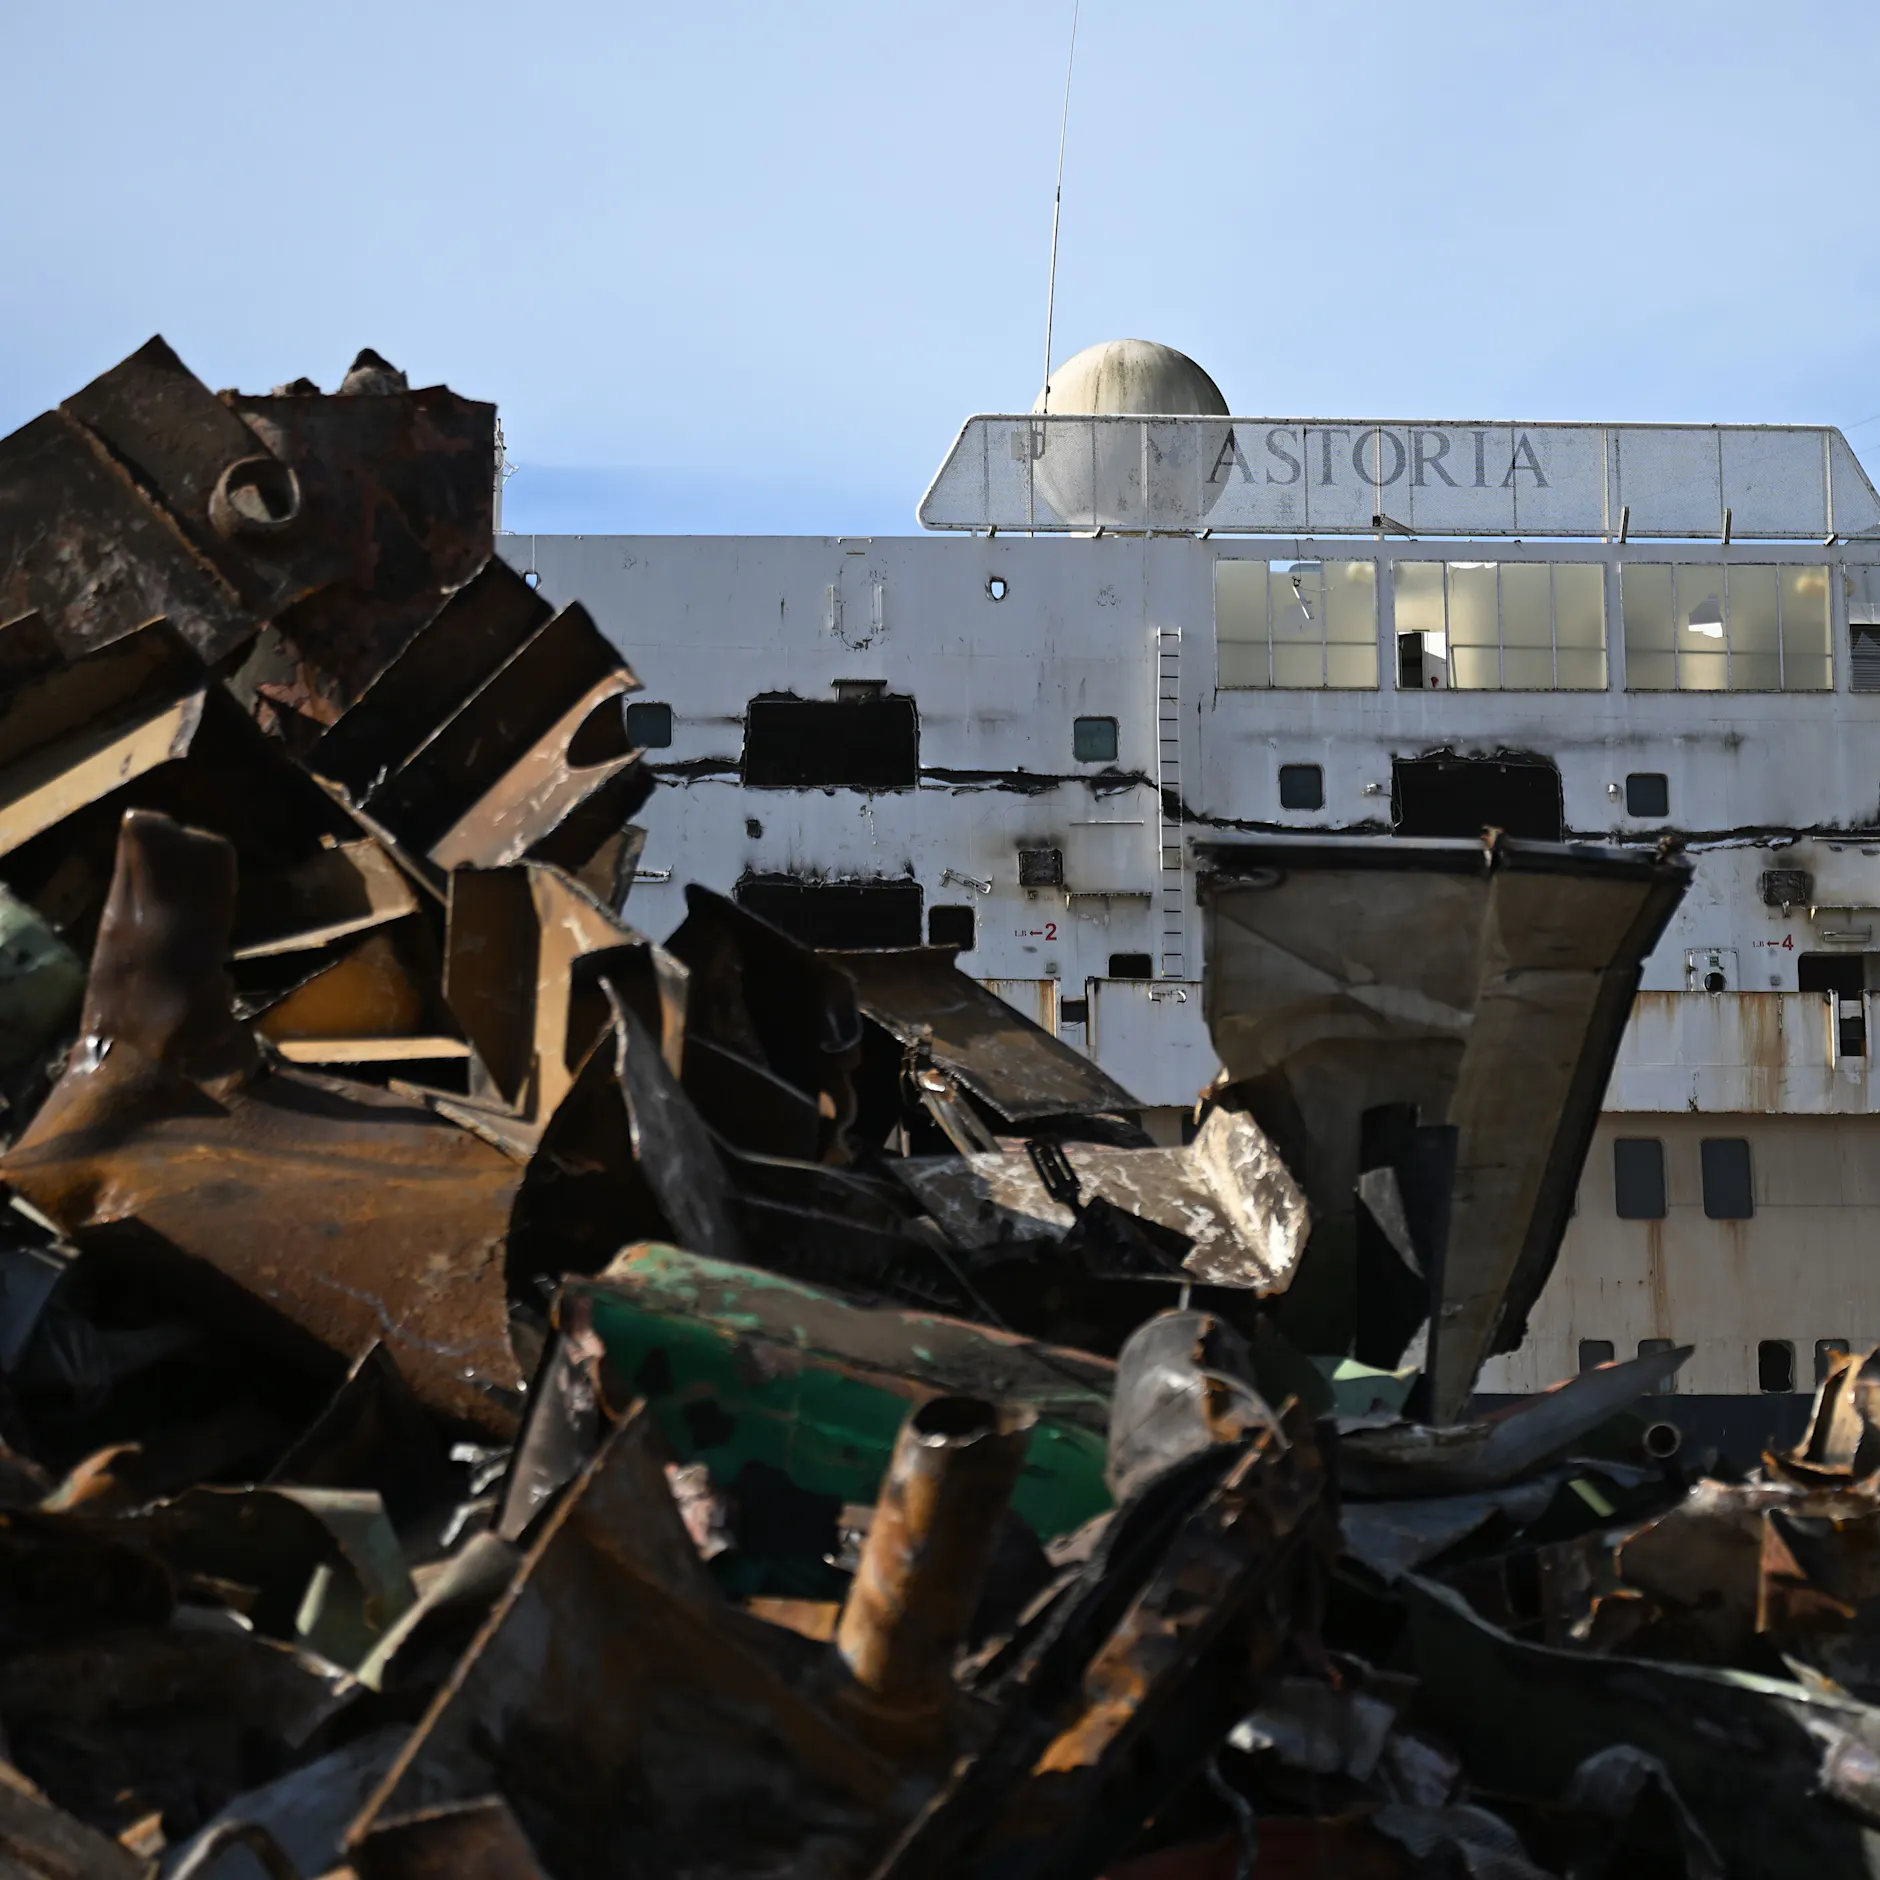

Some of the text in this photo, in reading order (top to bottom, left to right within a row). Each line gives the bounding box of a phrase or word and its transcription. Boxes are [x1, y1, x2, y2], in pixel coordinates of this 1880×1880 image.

[1205, 427, 1552, 488] ASTORIA
[1045, 923, 1057, 941] 2
[1781, 934, 1794, 951] 4
